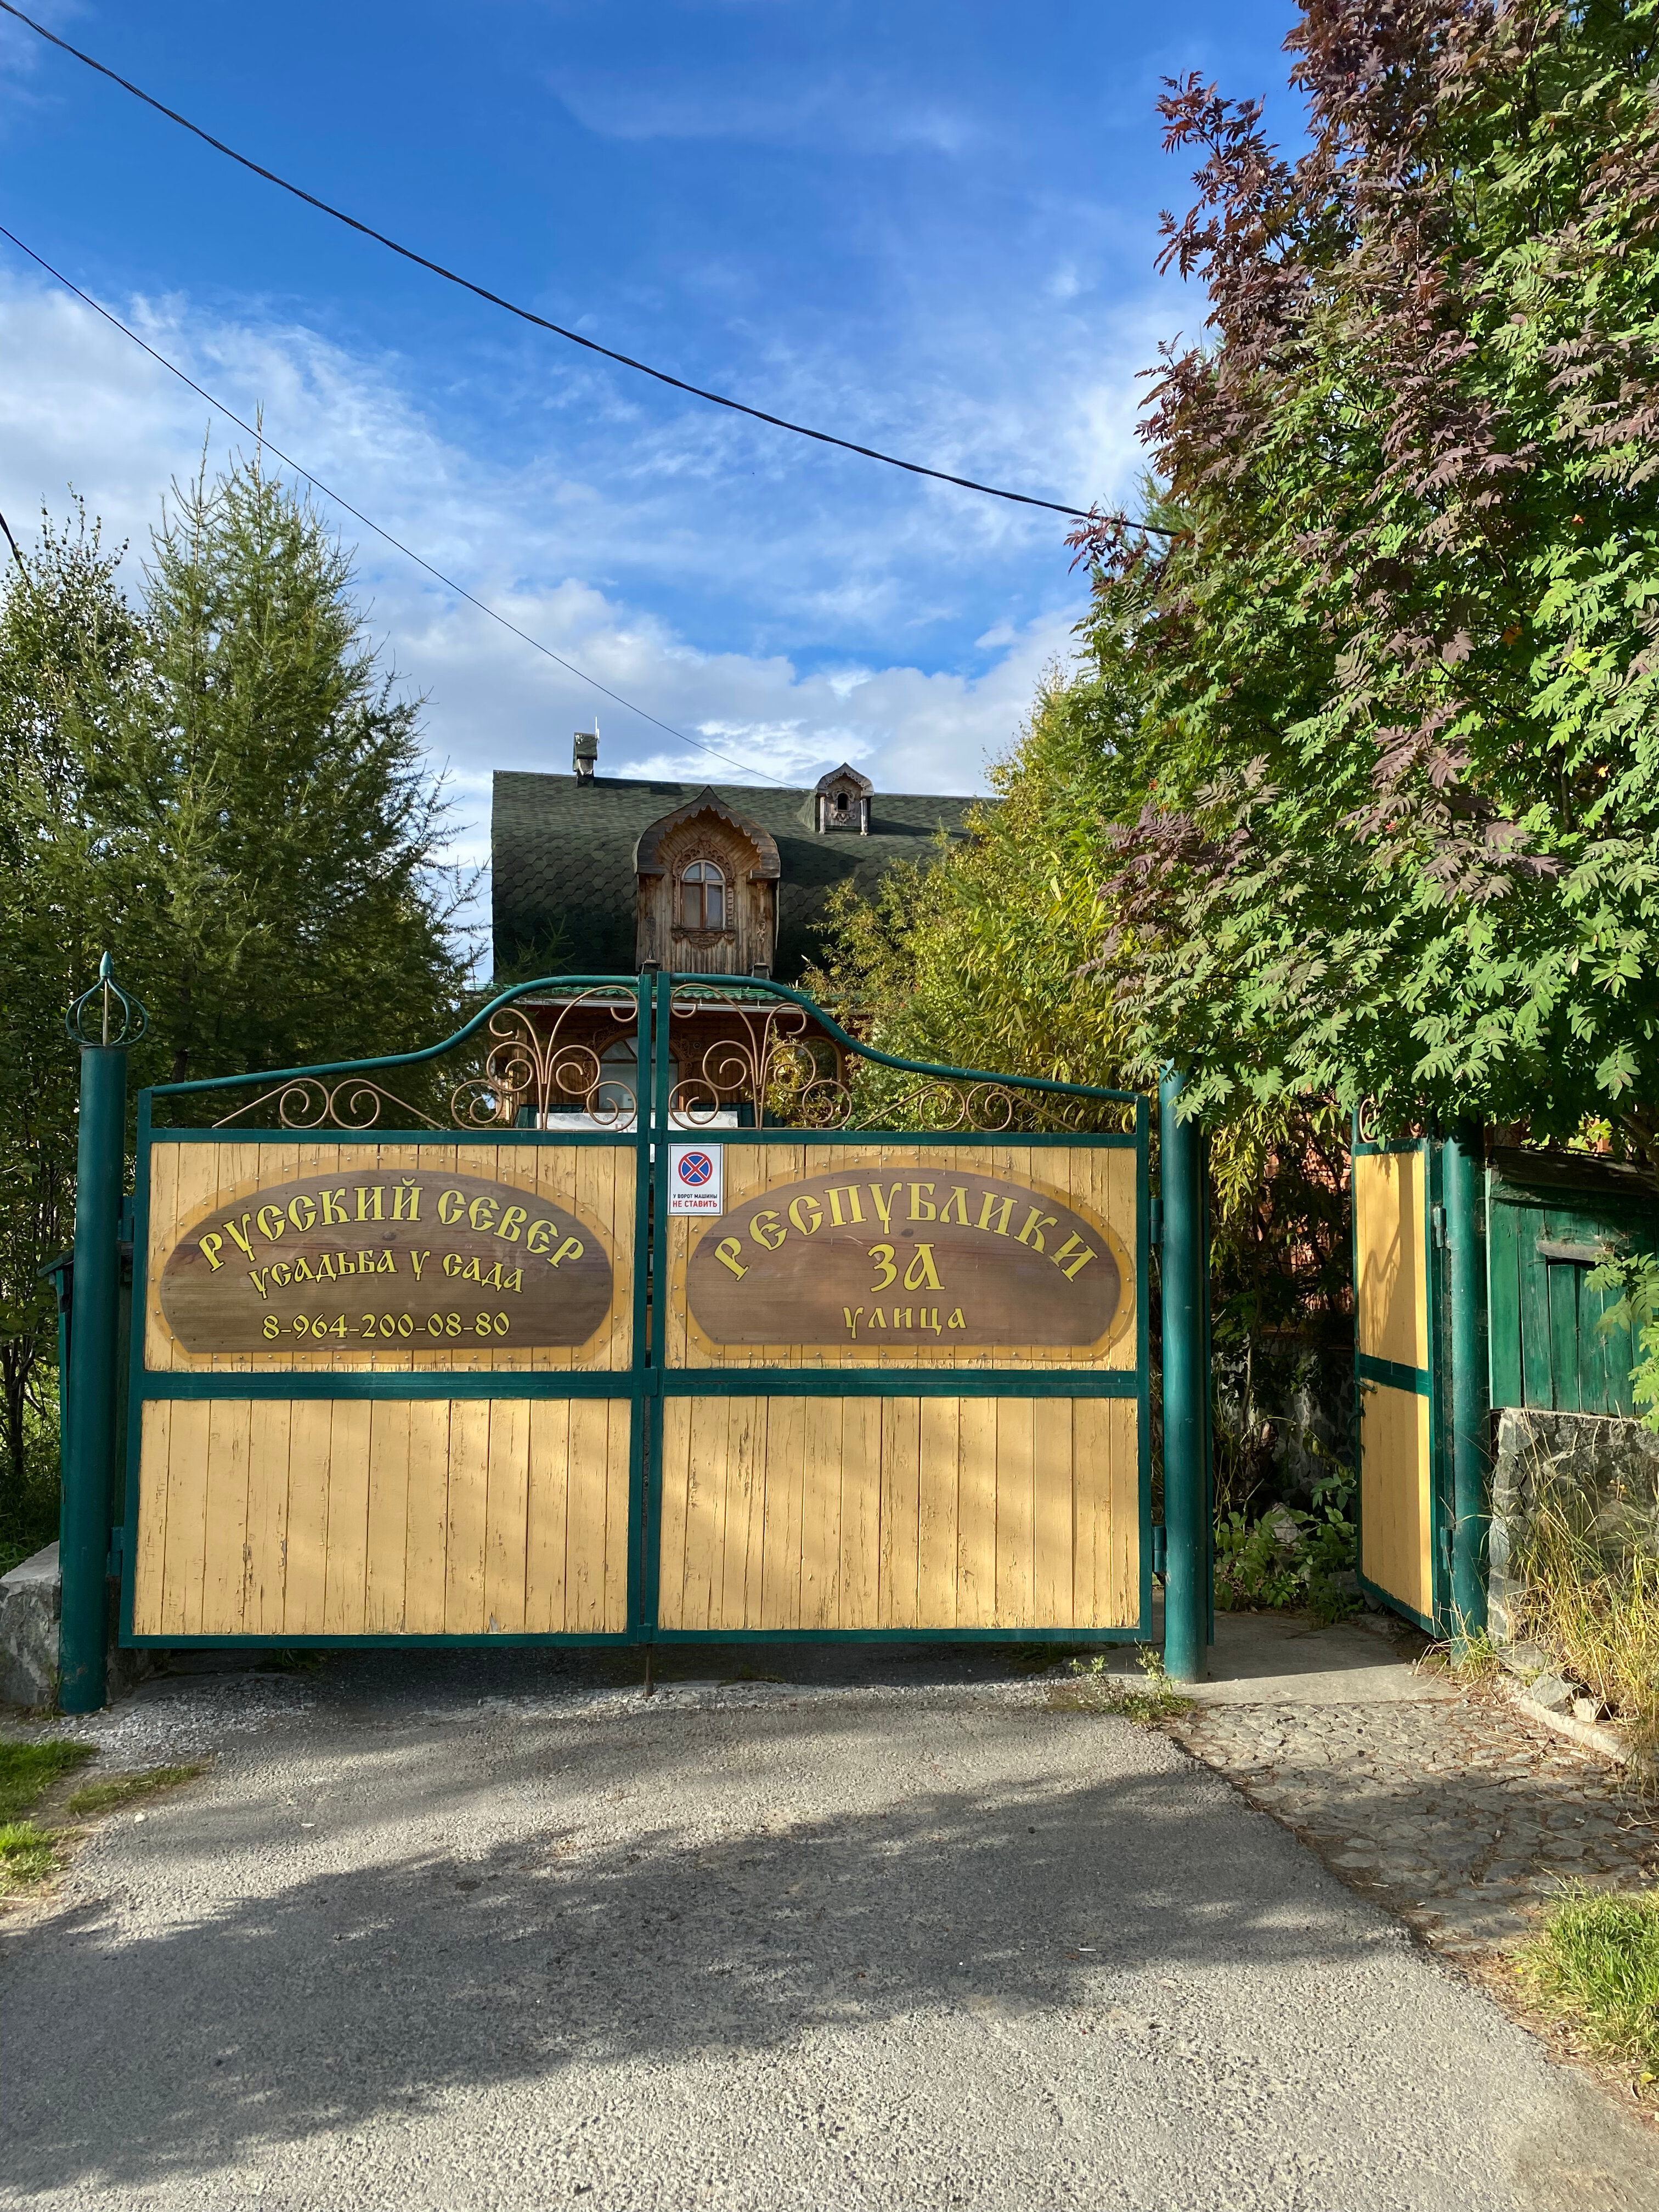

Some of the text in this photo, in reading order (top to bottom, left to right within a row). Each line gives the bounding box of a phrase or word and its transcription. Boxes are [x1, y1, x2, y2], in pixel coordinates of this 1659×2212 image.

[198, 1176, 585, 1273] РУССКИЙ СЕВЕР
[714, 1181, 1098, 1283] РЕСПУБЛИКИ
[262, 1312, 511, 1340] 8-964-200-08-80
